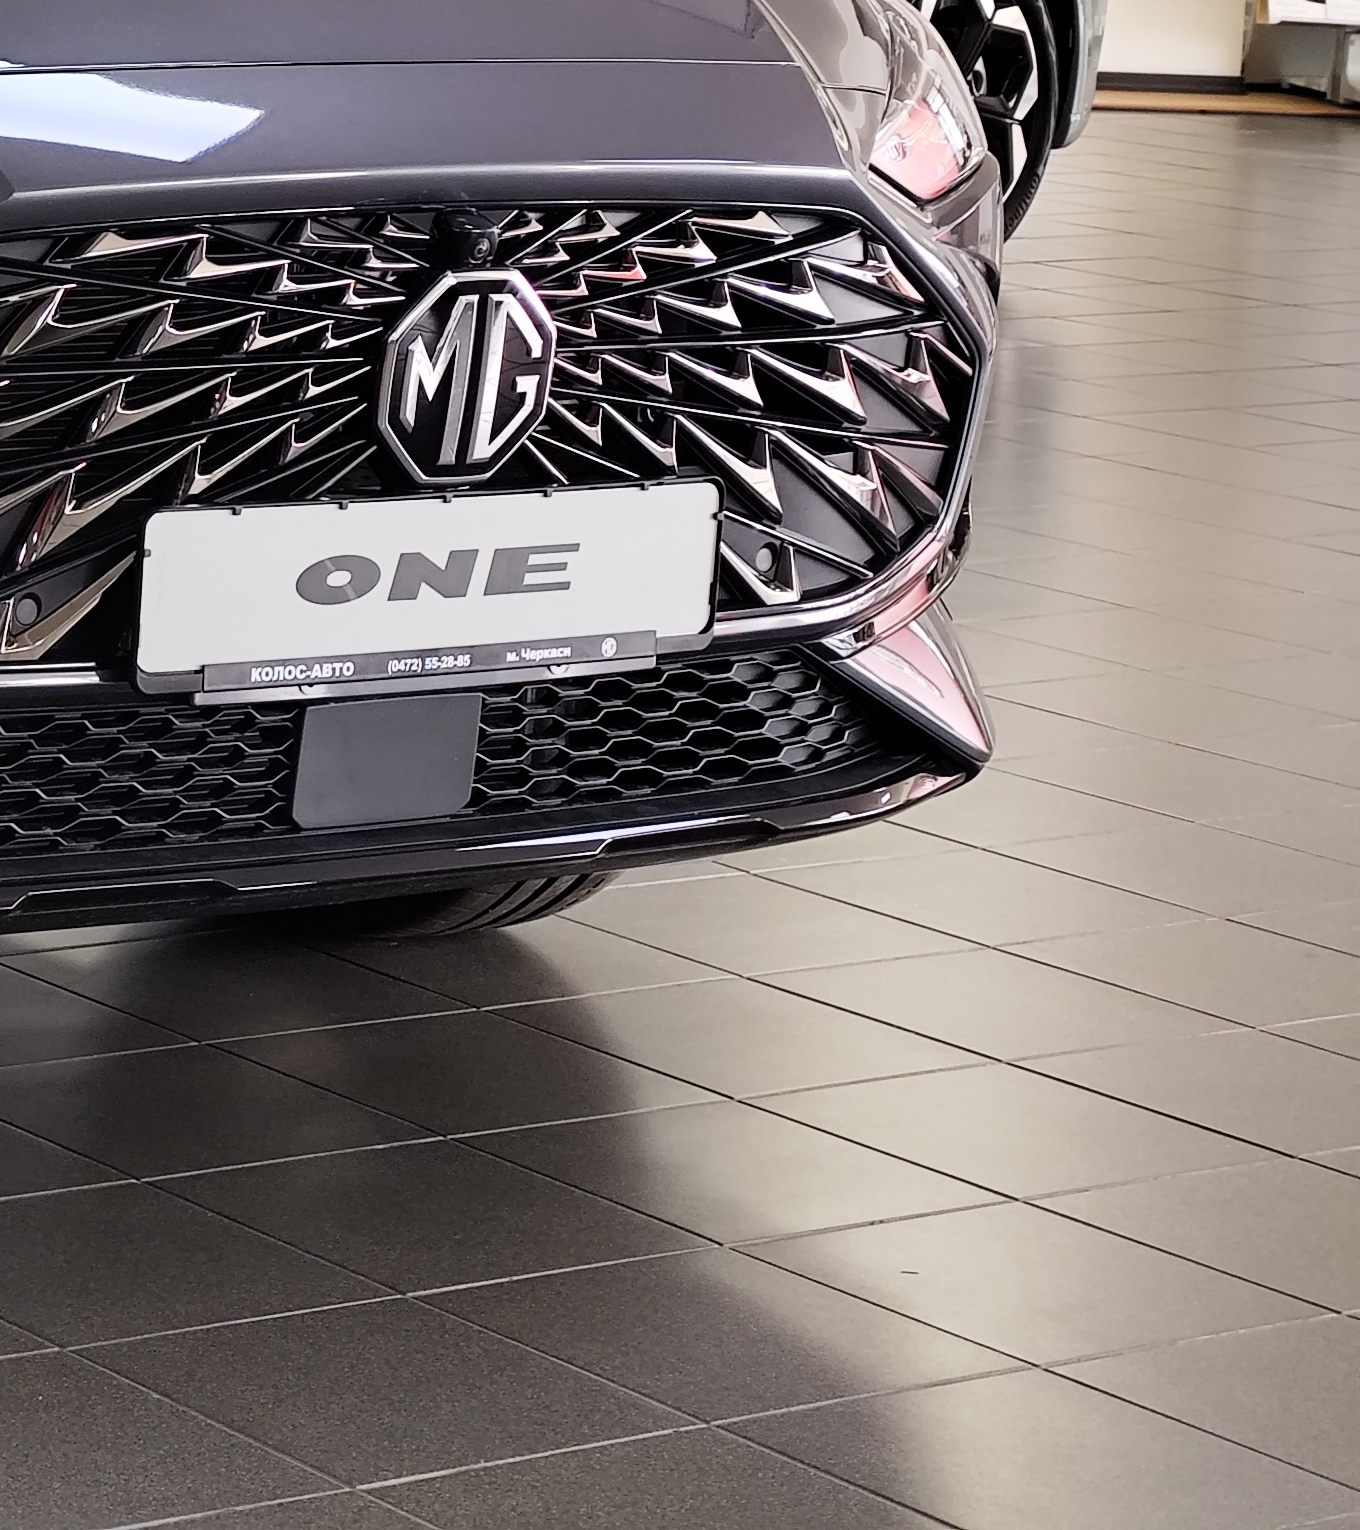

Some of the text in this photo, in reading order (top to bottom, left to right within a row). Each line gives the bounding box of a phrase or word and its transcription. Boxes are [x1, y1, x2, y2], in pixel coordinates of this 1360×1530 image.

[397, 291, 546, 467] MG
[295, 542, 581, 606] ONE
[250, 660, 356, 683] КОЛОС-АВТО
[387, 657, 423, 676] (0472)
[423, 653, 472, 670] 55-28-85
[520, 645, 572, 662] Черкаси
